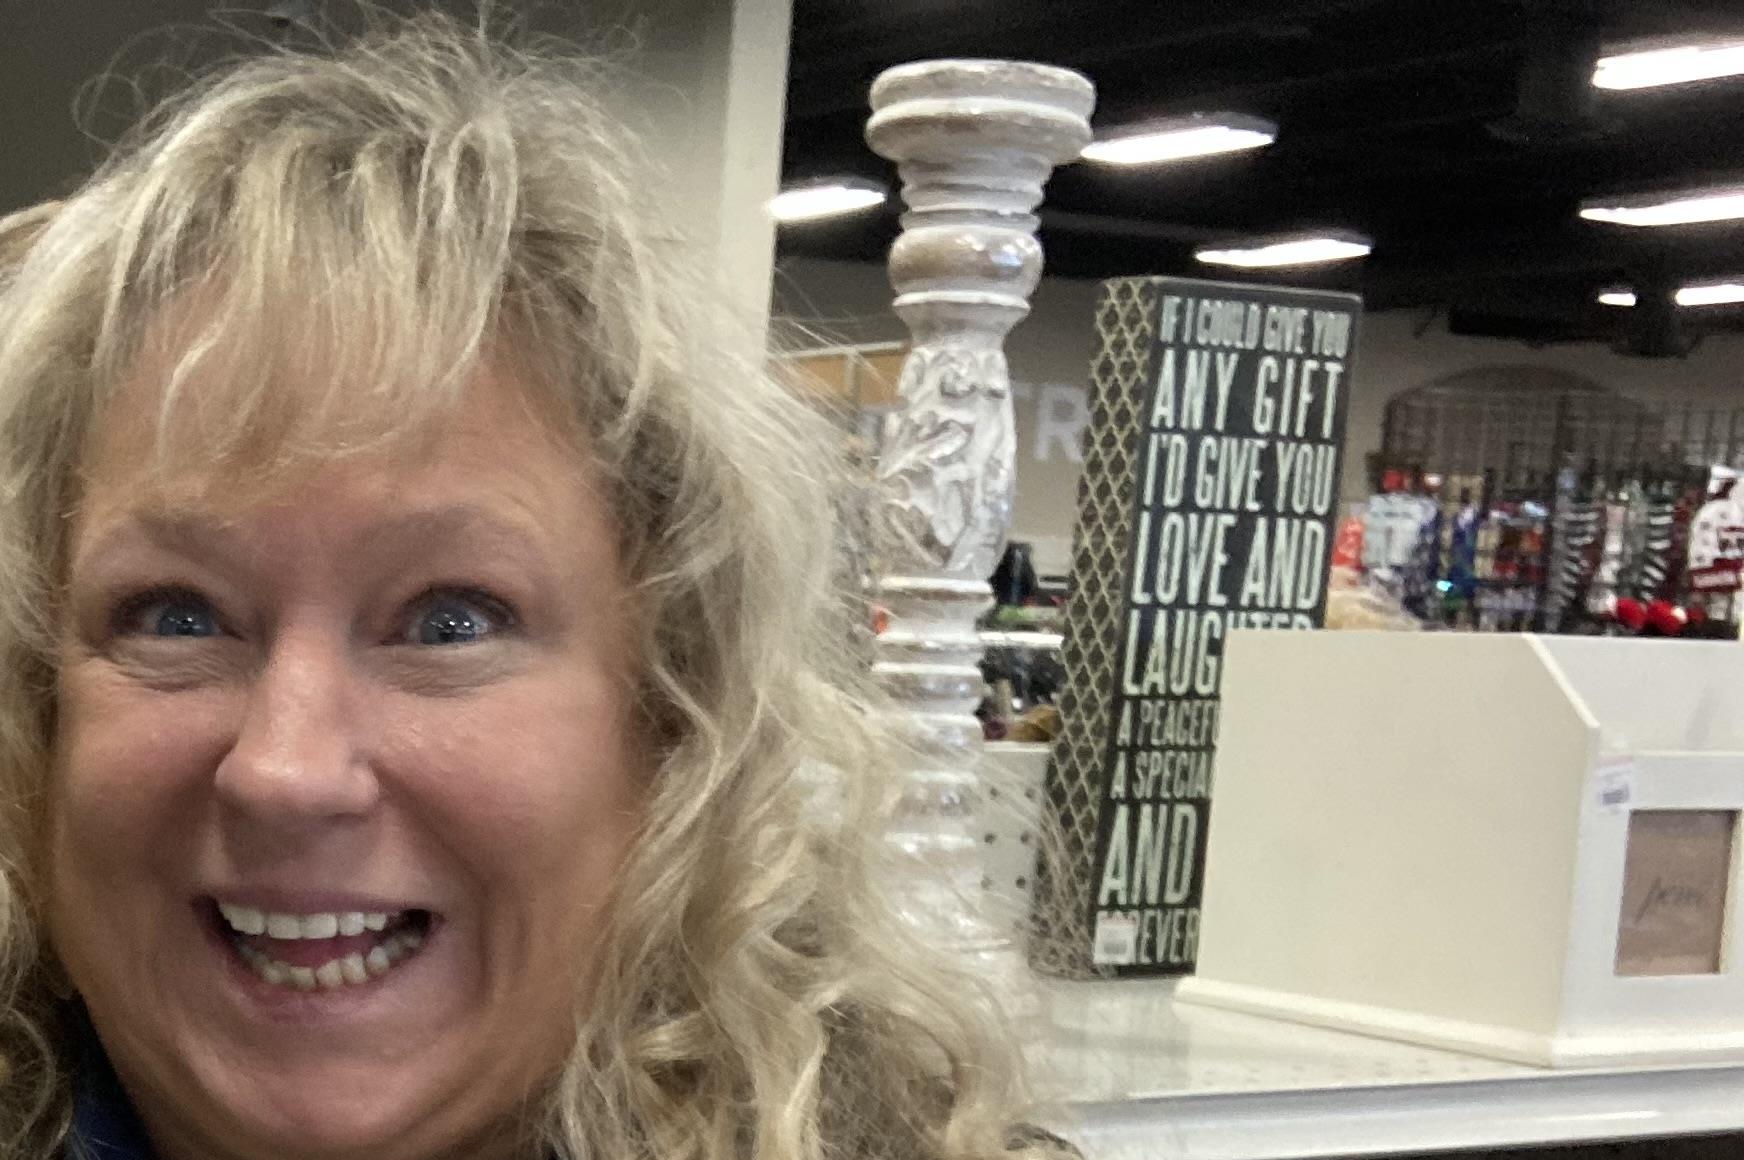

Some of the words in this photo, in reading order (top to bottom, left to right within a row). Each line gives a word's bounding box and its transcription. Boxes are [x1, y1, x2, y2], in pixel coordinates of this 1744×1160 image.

[1151, 349, 1240, 431] ANY
[1252, 355, 1344, 439] GIFT
[1143, 433, 1189, 508] I'D
[1194, 434, 1268, 513] GIVE
[1271, 440, 1337, 516] YOU
[1131, 510, 1238, 606] LOVE
[1240, 515, 1327, 610] AND
[1116, 699, 1133, 747] A
[1109, 750, 1127, 800] A
[1131, 751, 1212, 799] SPECIA
[1099, 803, 1198, 906] AND
